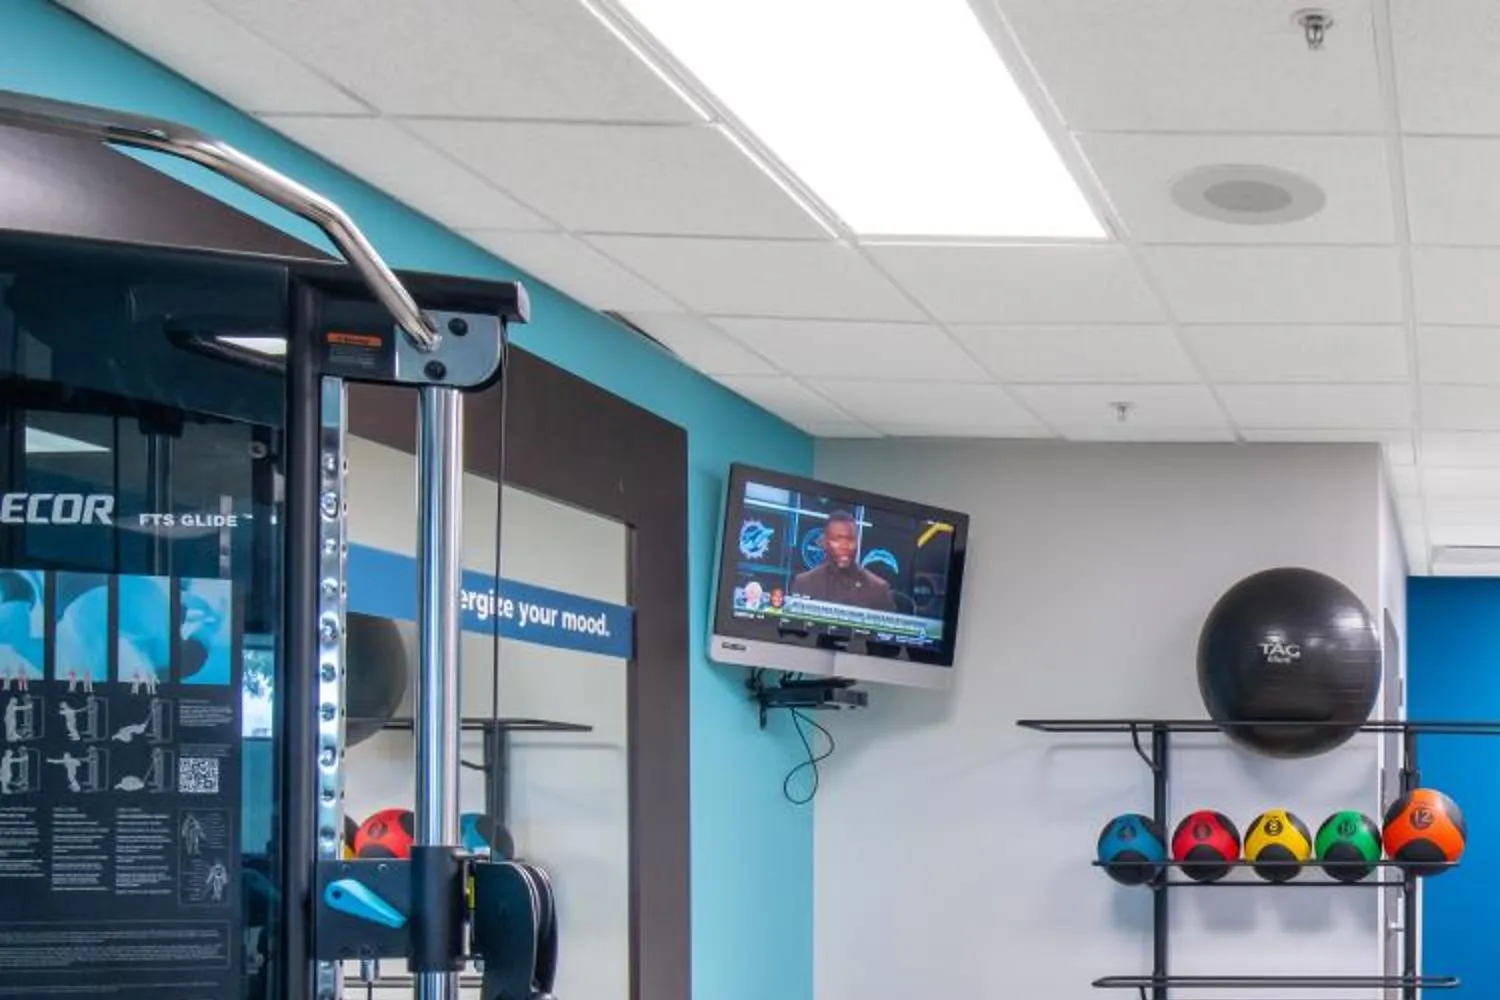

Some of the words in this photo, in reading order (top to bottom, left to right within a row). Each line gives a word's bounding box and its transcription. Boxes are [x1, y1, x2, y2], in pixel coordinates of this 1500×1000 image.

[139, 513, 174, 527] FTS
[181, 514, 238, 527] GLIDE
[518, 602, 558, 628] your
[561, 613, 611, 637] mood.
